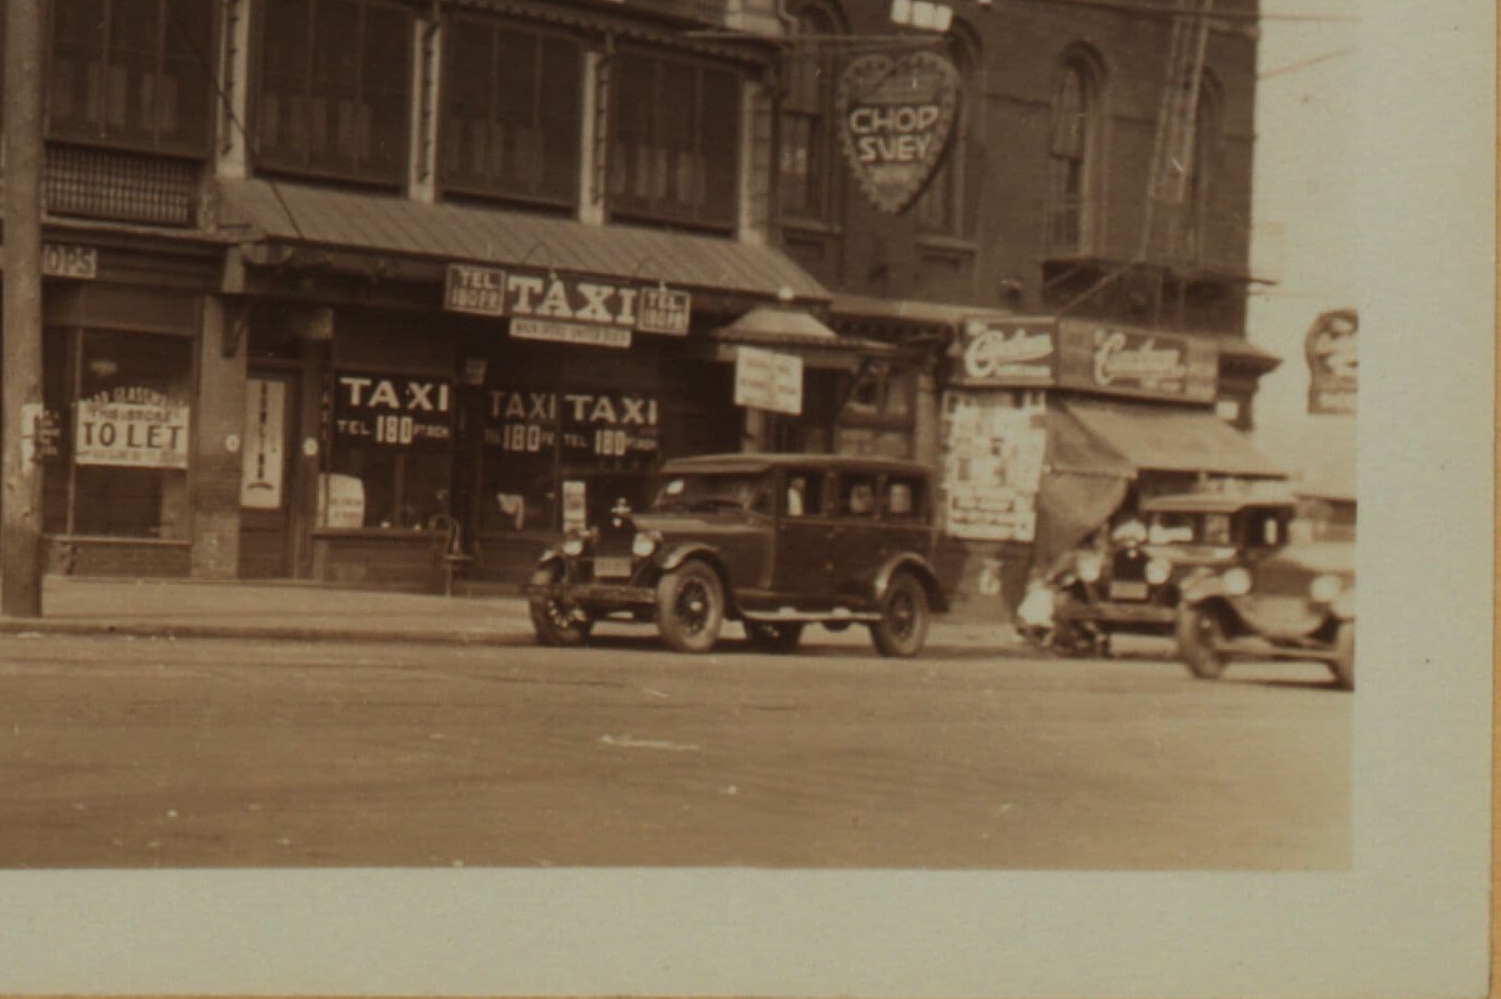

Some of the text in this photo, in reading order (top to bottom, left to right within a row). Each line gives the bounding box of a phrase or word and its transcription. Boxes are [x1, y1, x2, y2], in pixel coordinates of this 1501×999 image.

[849, 105, 940, 134] CHOP
[858, 133, 933, 162] SUEY
[507, 274, 638, 325] TAXI
[338, 376, 450, 412] TAXI
[489, 391, 556, 422] TAXI
[564, 394, 659, 426] TAXI
[83, 421, 116, 447] TO
[125, 423, 184, 450] LET
[337, 419, 371, 436] TEL
[376, 414, 413, 444] 180
[502, 424, 541, 452] 180
[594, 429, 627, 456] 180
